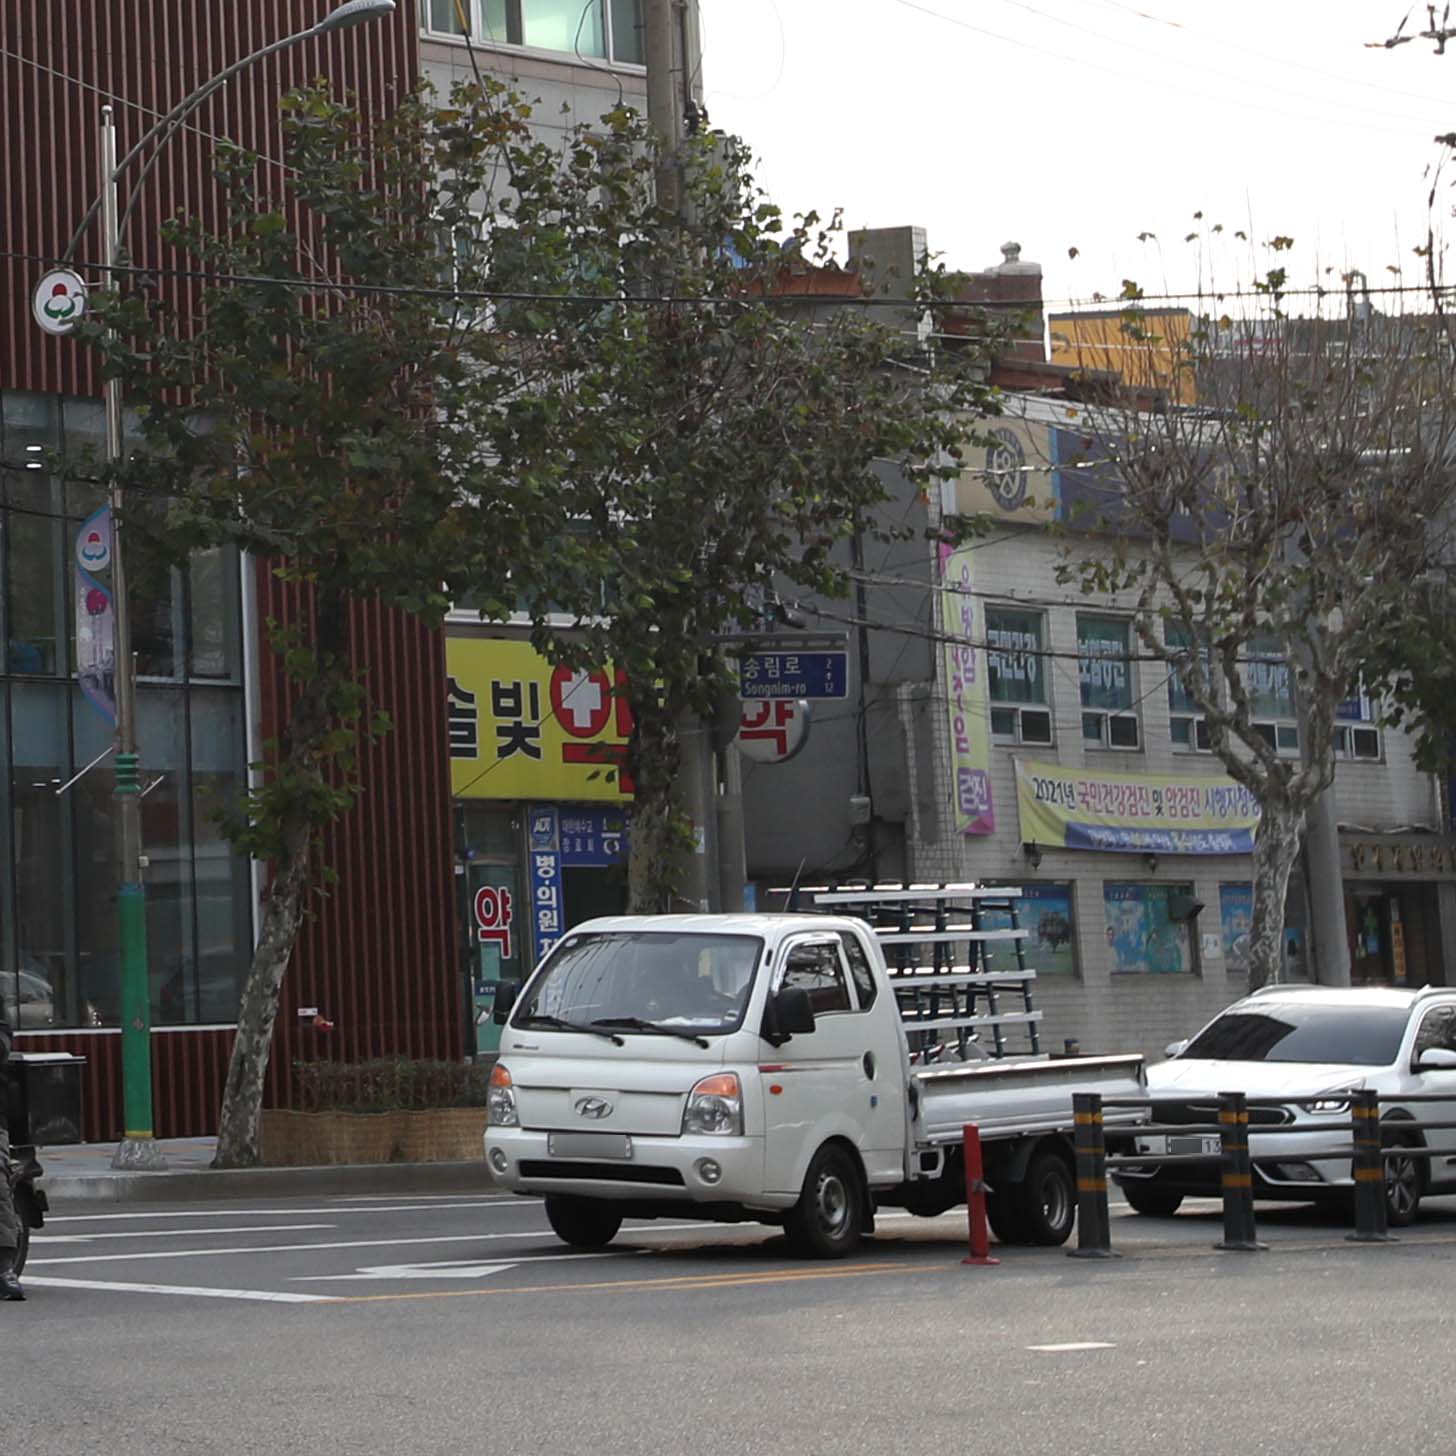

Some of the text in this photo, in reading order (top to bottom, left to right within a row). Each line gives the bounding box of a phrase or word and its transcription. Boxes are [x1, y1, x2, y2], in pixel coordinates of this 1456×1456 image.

[743, 656, 802, 680] 송림로
[744, 681, 807, 697] Songnim-ro
[1032, 776, 1076, 811] 2021년
[1077, 780, 1151, 817] 국민건강검진
[1165, 786, 1202, 818] 암검진
[474, 885, 513, 960] 약
